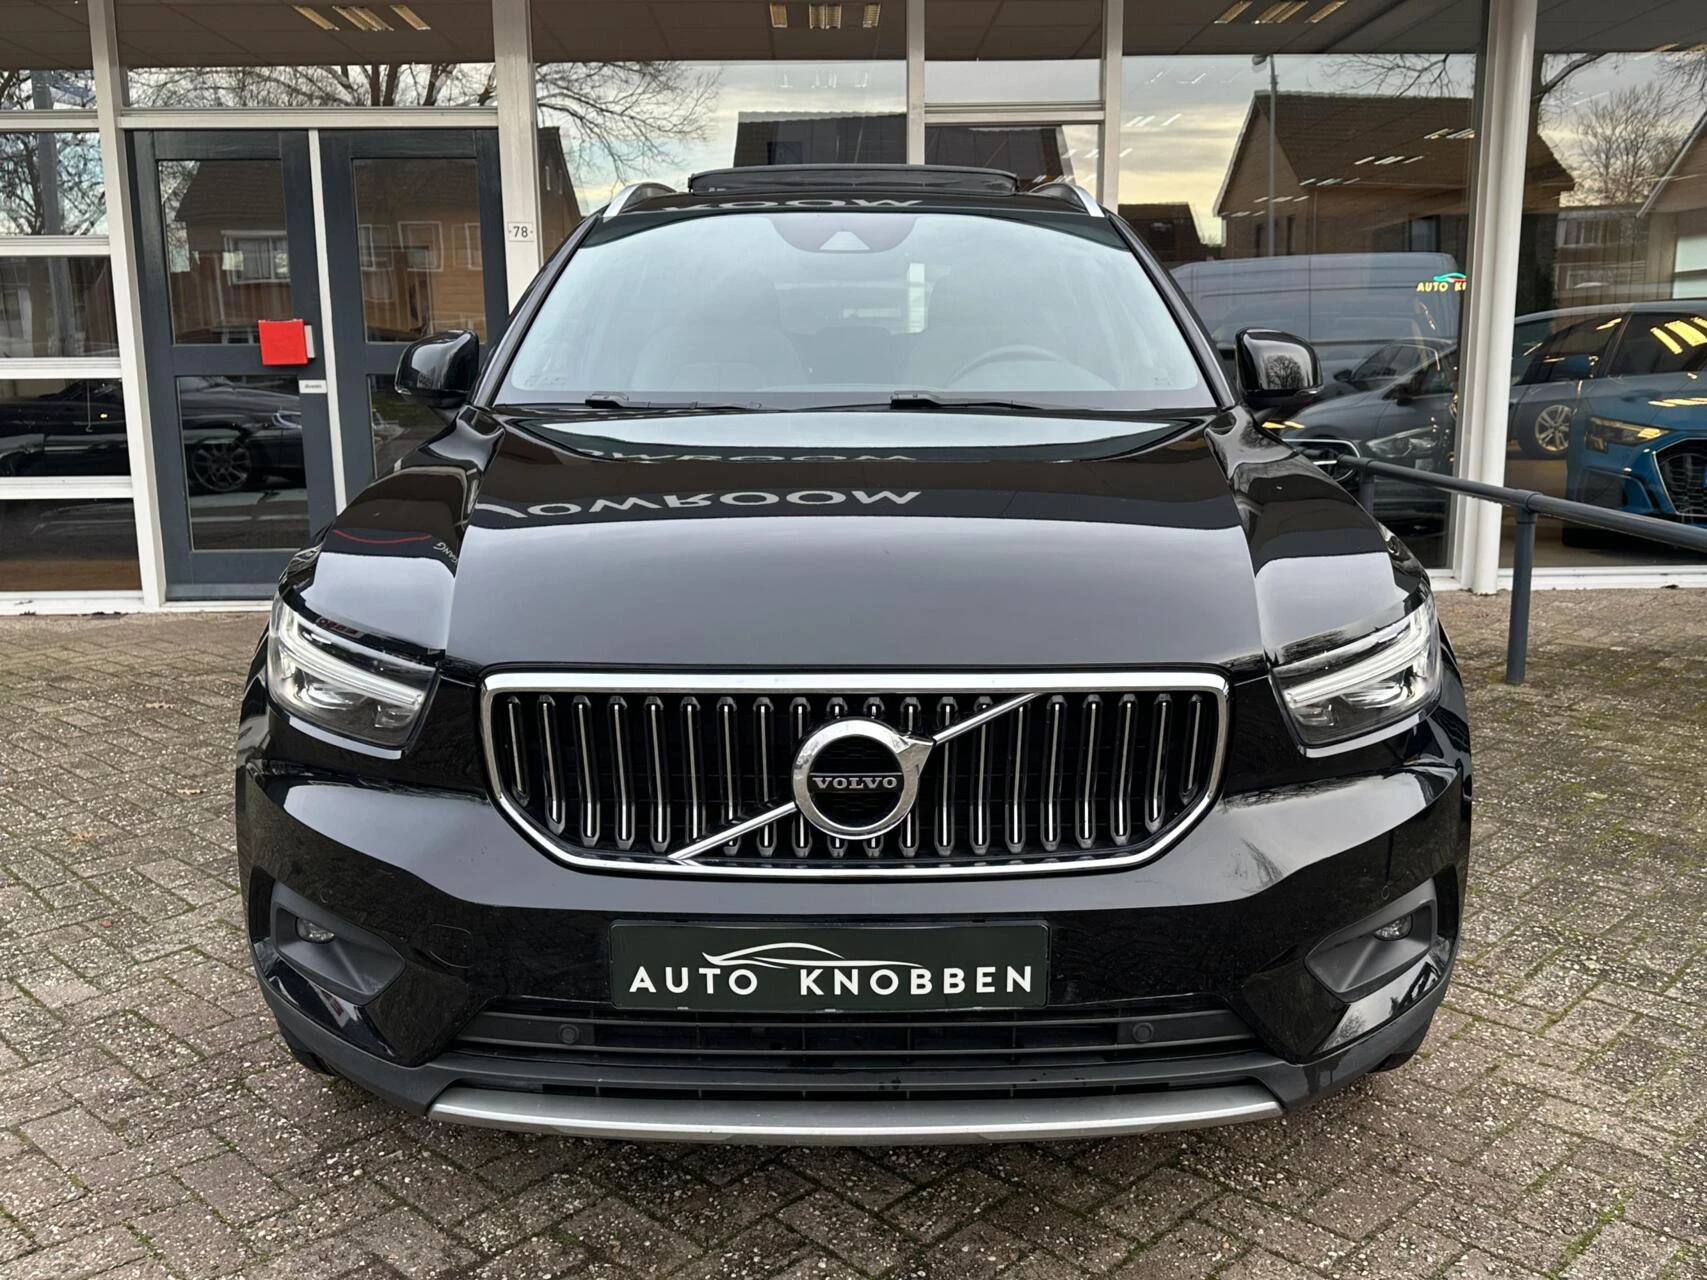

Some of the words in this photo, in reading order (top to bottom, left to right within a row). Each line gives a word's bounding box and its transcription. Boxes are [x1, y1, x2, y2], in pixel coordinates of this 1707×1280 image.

[513, 225, 529, 238] 78
[1416, 281, 1449, 292] AUTO
[812, 776, 898, 789] VOLVO
[629, 965, 758, 996] AUTO
[799, 965, 1033, 996] KNOBBEN
